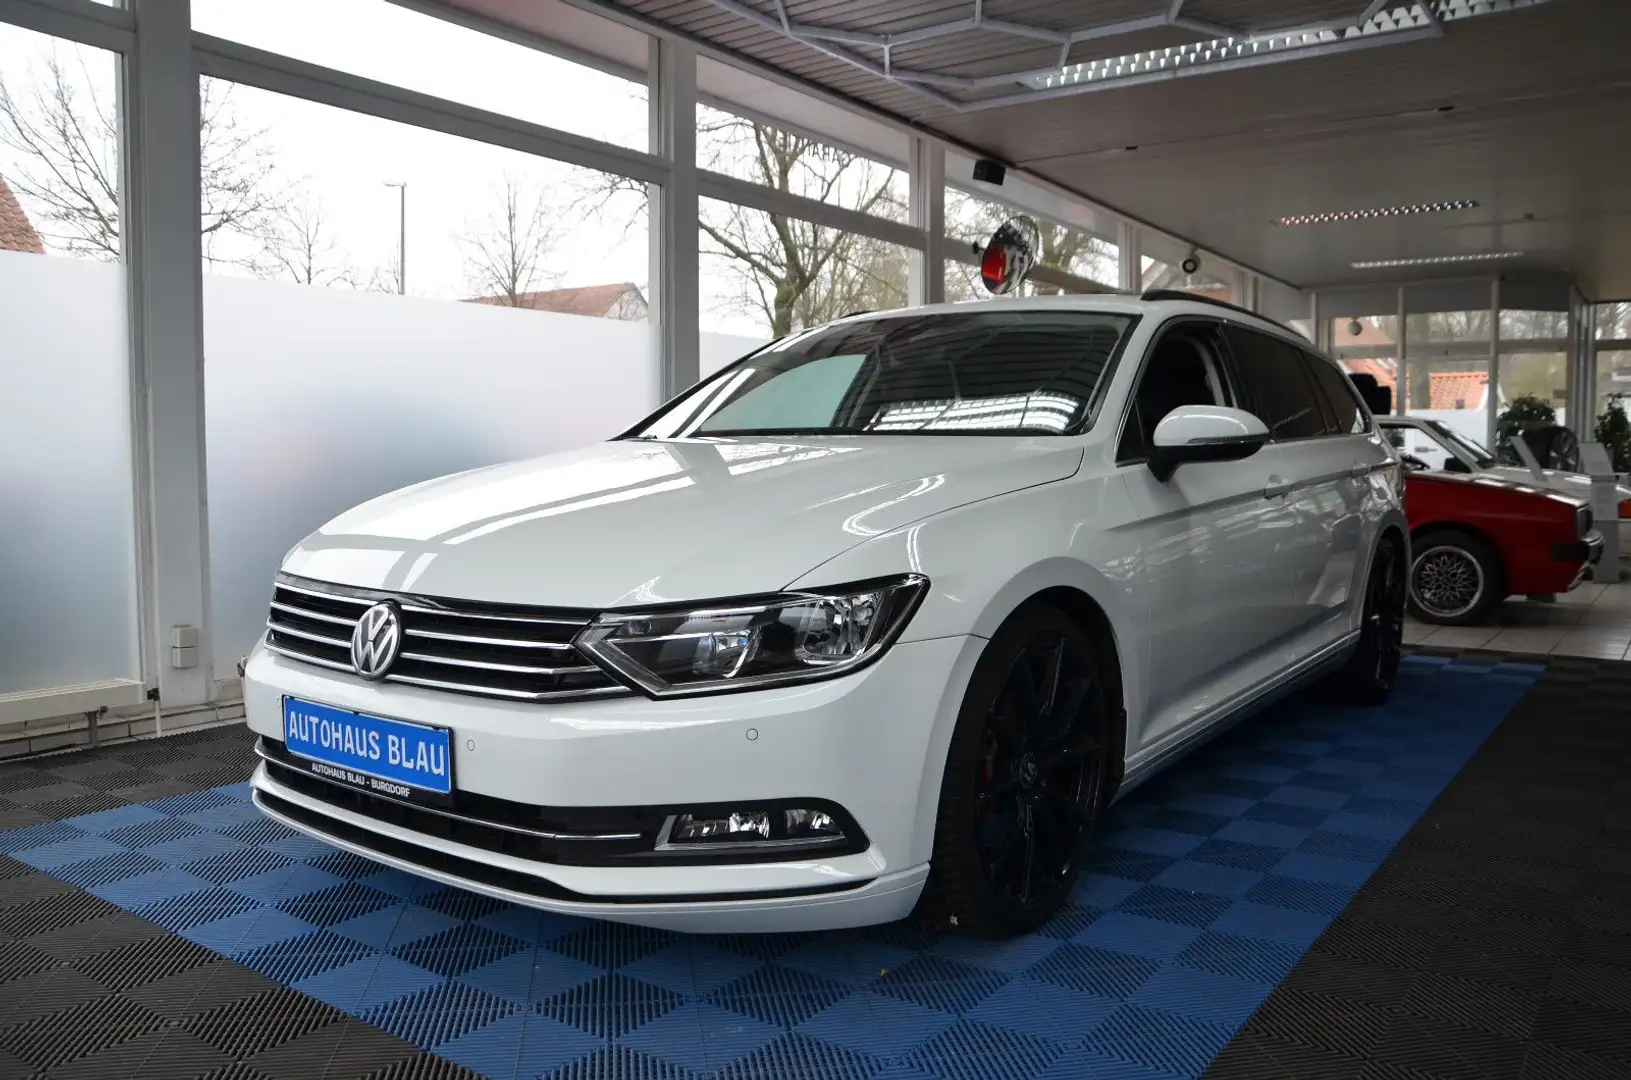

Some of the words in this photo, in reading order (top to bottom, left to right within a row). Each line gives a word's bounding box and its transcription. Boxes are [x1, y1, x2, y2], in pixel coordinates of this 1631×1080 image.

[289, 711, 381, 760] AUTOHAUS
[388, 734, 445, 777] BLAU
[312, 762, 346, 780] AUTOHAUS
[347, 772, 365, 785] BLAU
[371, 778, 411, 798] BURGDORF
